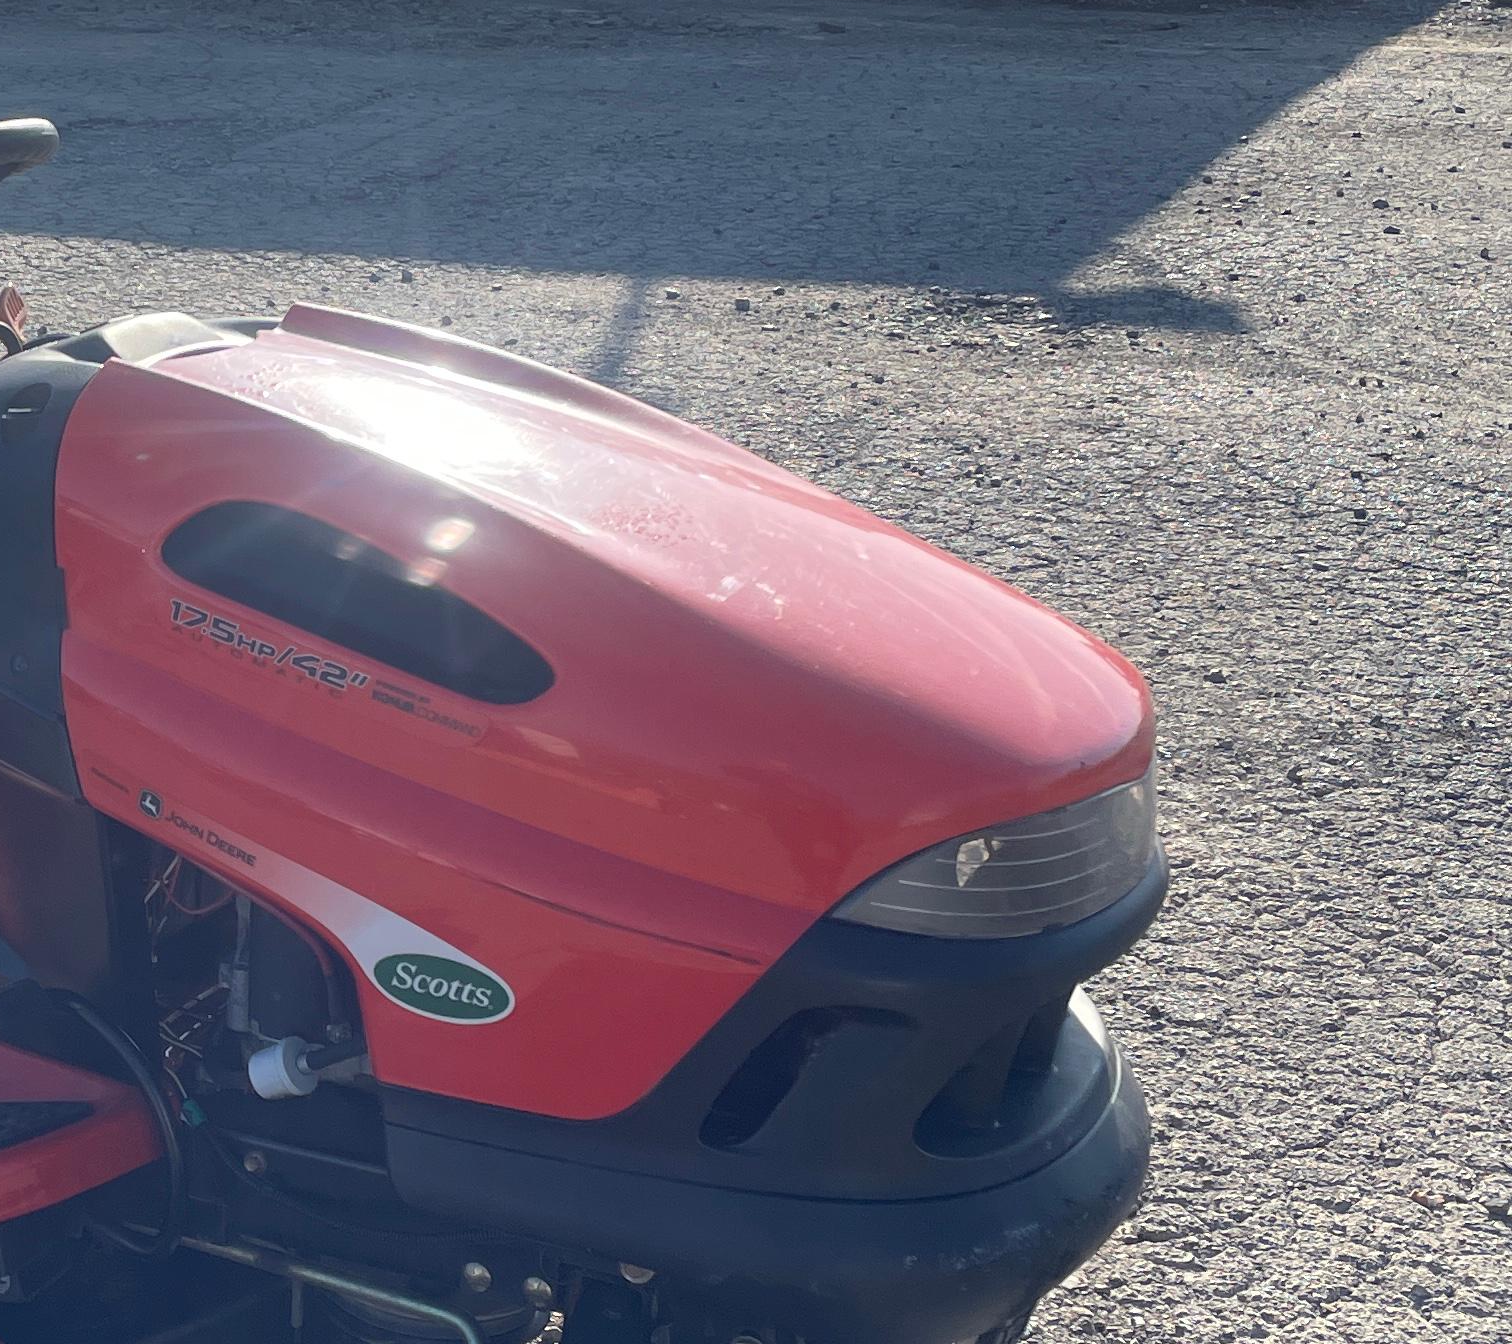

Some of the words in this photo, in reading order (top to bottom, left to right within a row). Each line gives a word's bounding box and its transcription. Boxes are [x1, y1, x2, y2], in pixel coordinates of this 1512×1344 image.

[165, 809, 204, 839] JOHN
[206, 829, 256, 866] DEERE
[391, 962, 492, 1007] Scotts
